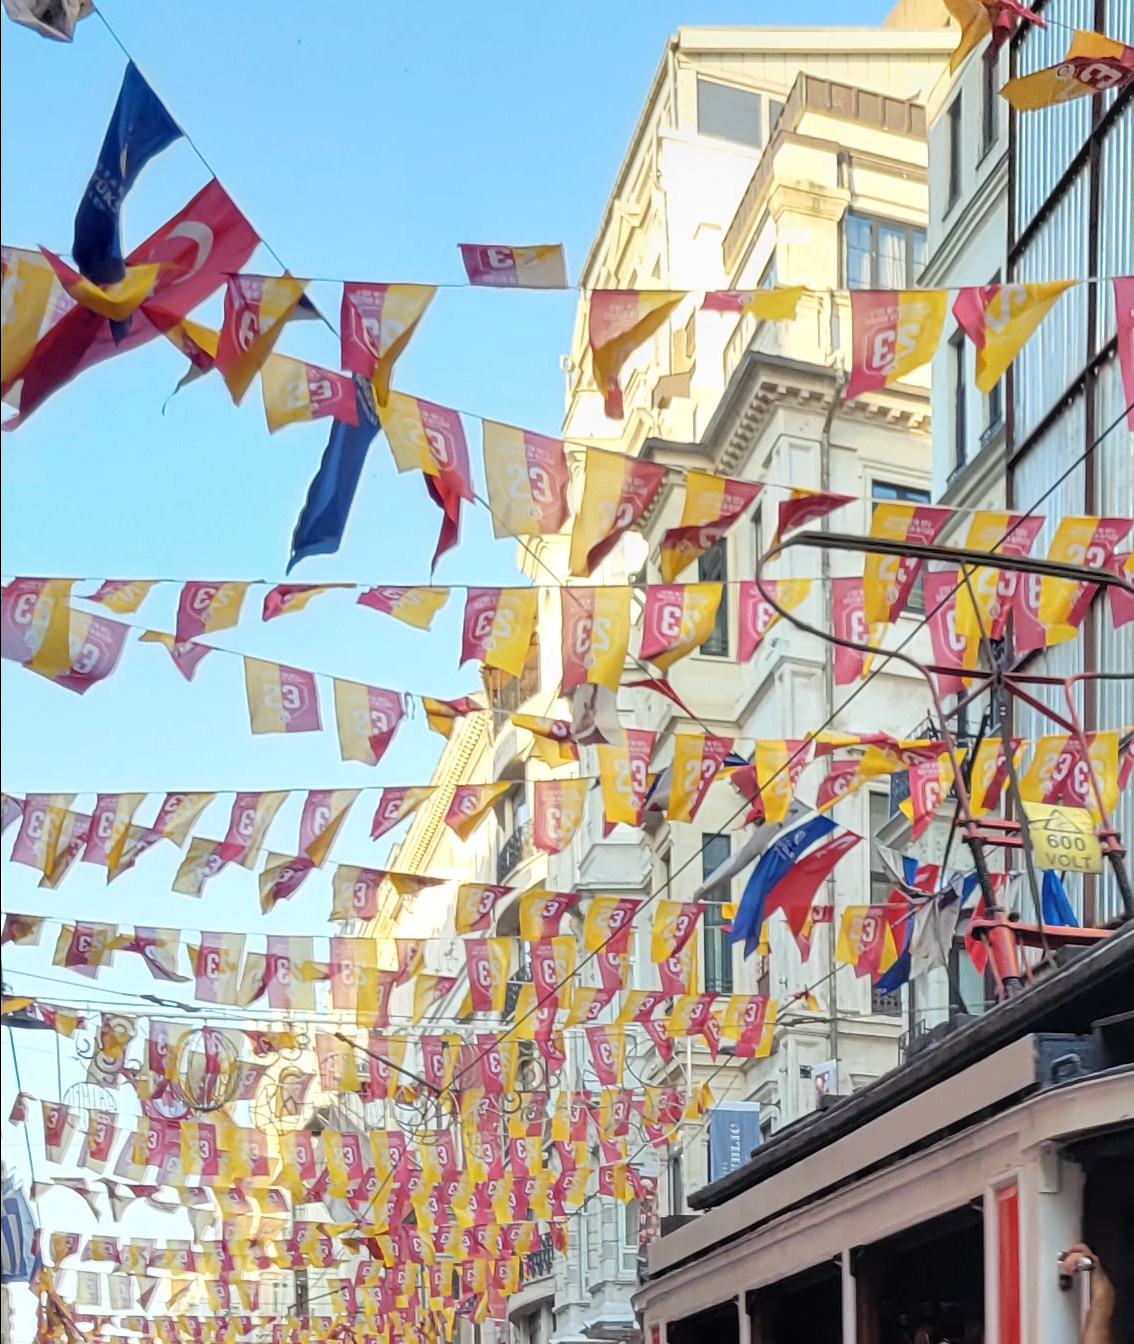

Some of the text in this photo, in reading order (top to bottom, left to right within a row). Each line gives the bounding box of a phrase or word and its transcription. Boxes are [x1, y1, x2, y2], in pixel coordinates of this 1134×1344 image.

[507, 463, 551, 504] 23
[614, 759, 649, 794] 23
[1047, 833, 1087, 852] 600
[1045, 853, 1093, 869] VOLT
